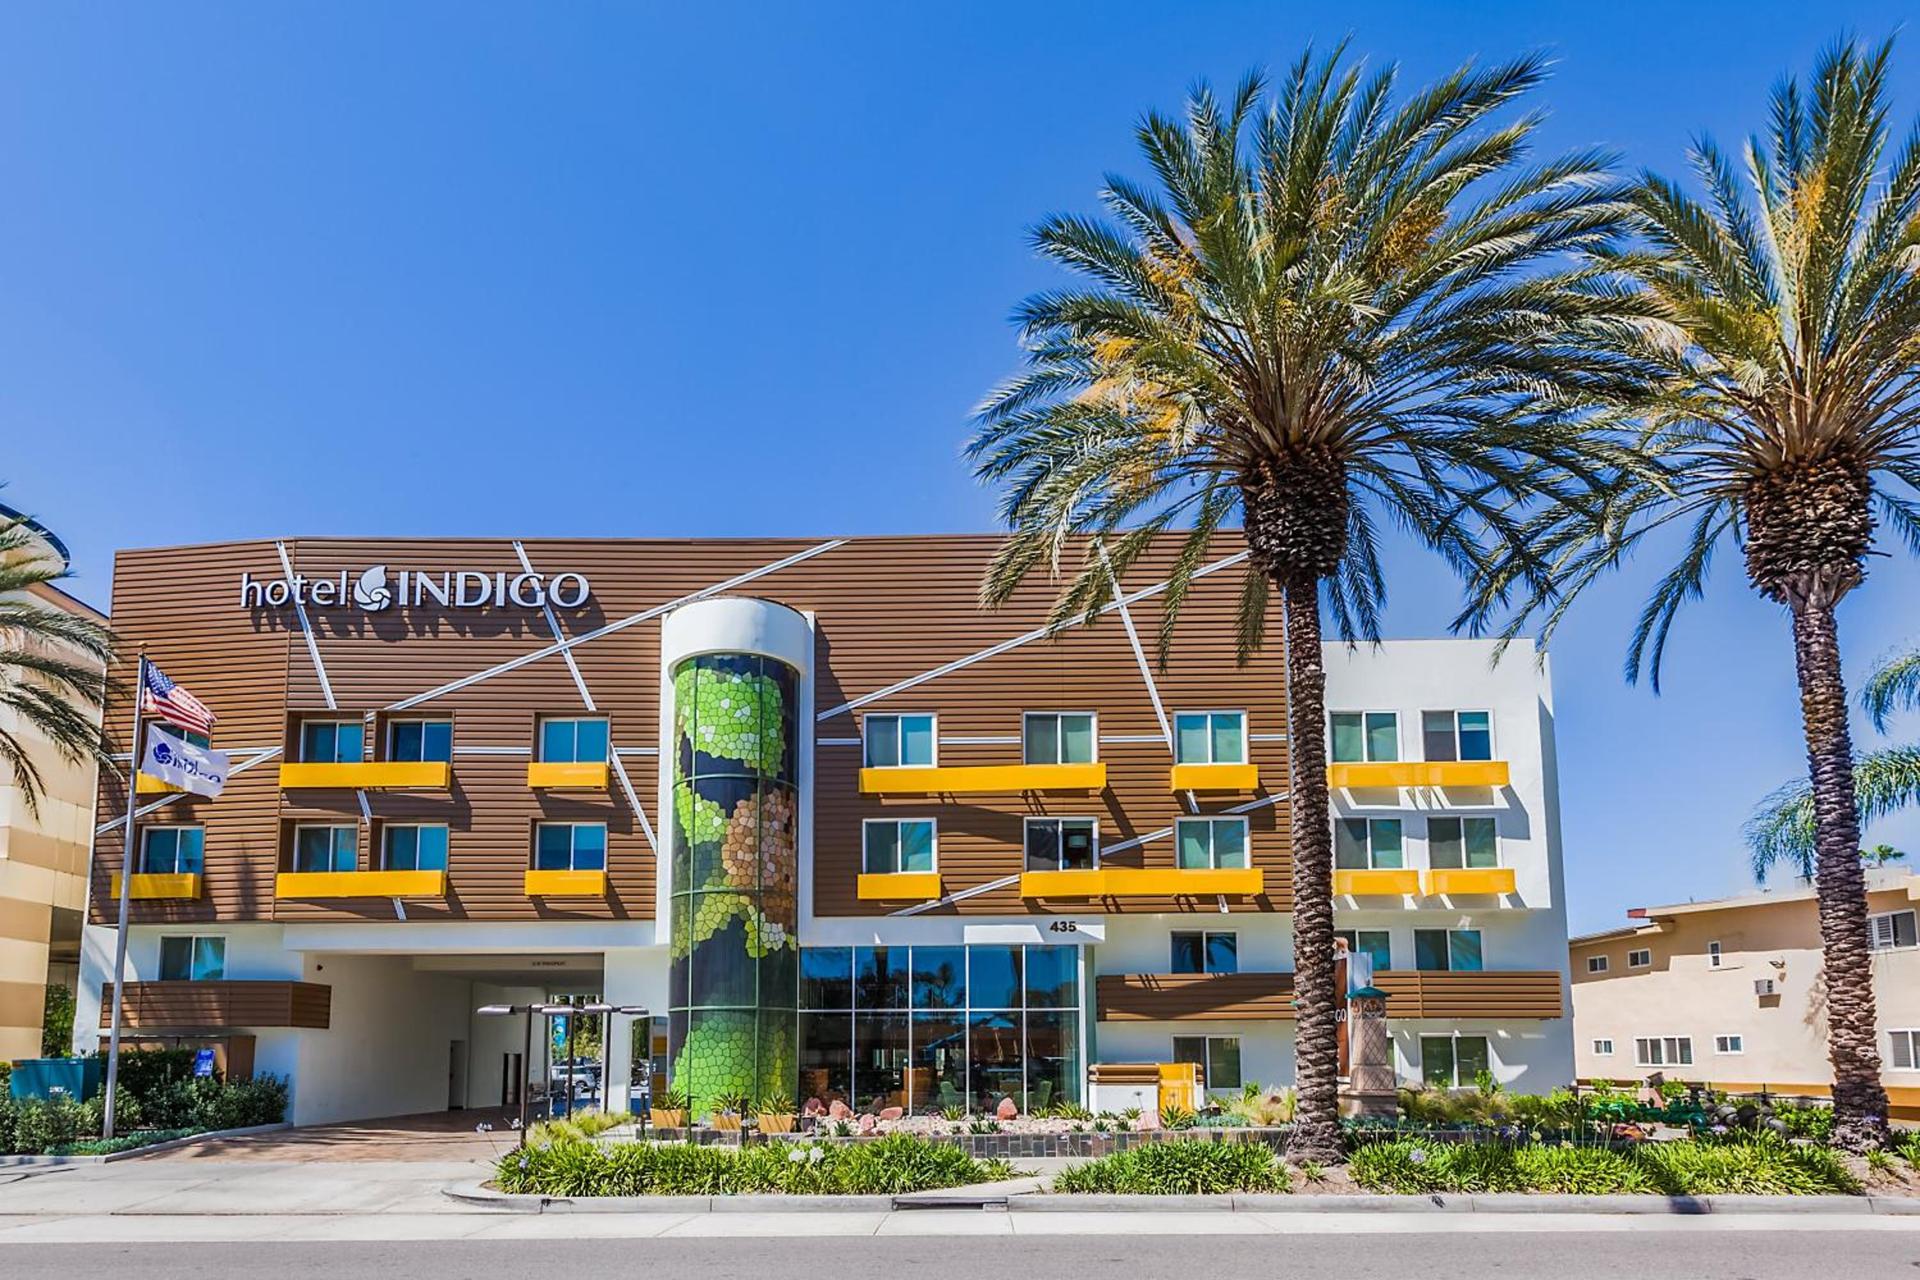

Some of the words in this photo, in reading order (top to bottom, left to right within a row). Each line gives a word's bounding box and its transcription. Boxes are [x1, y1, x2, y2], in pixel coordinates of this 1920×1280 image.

[240, 570, 348, 608] hotel
[398, 570, 591, 608] INDIGO
[1050, 921, 1077, 933] 435
